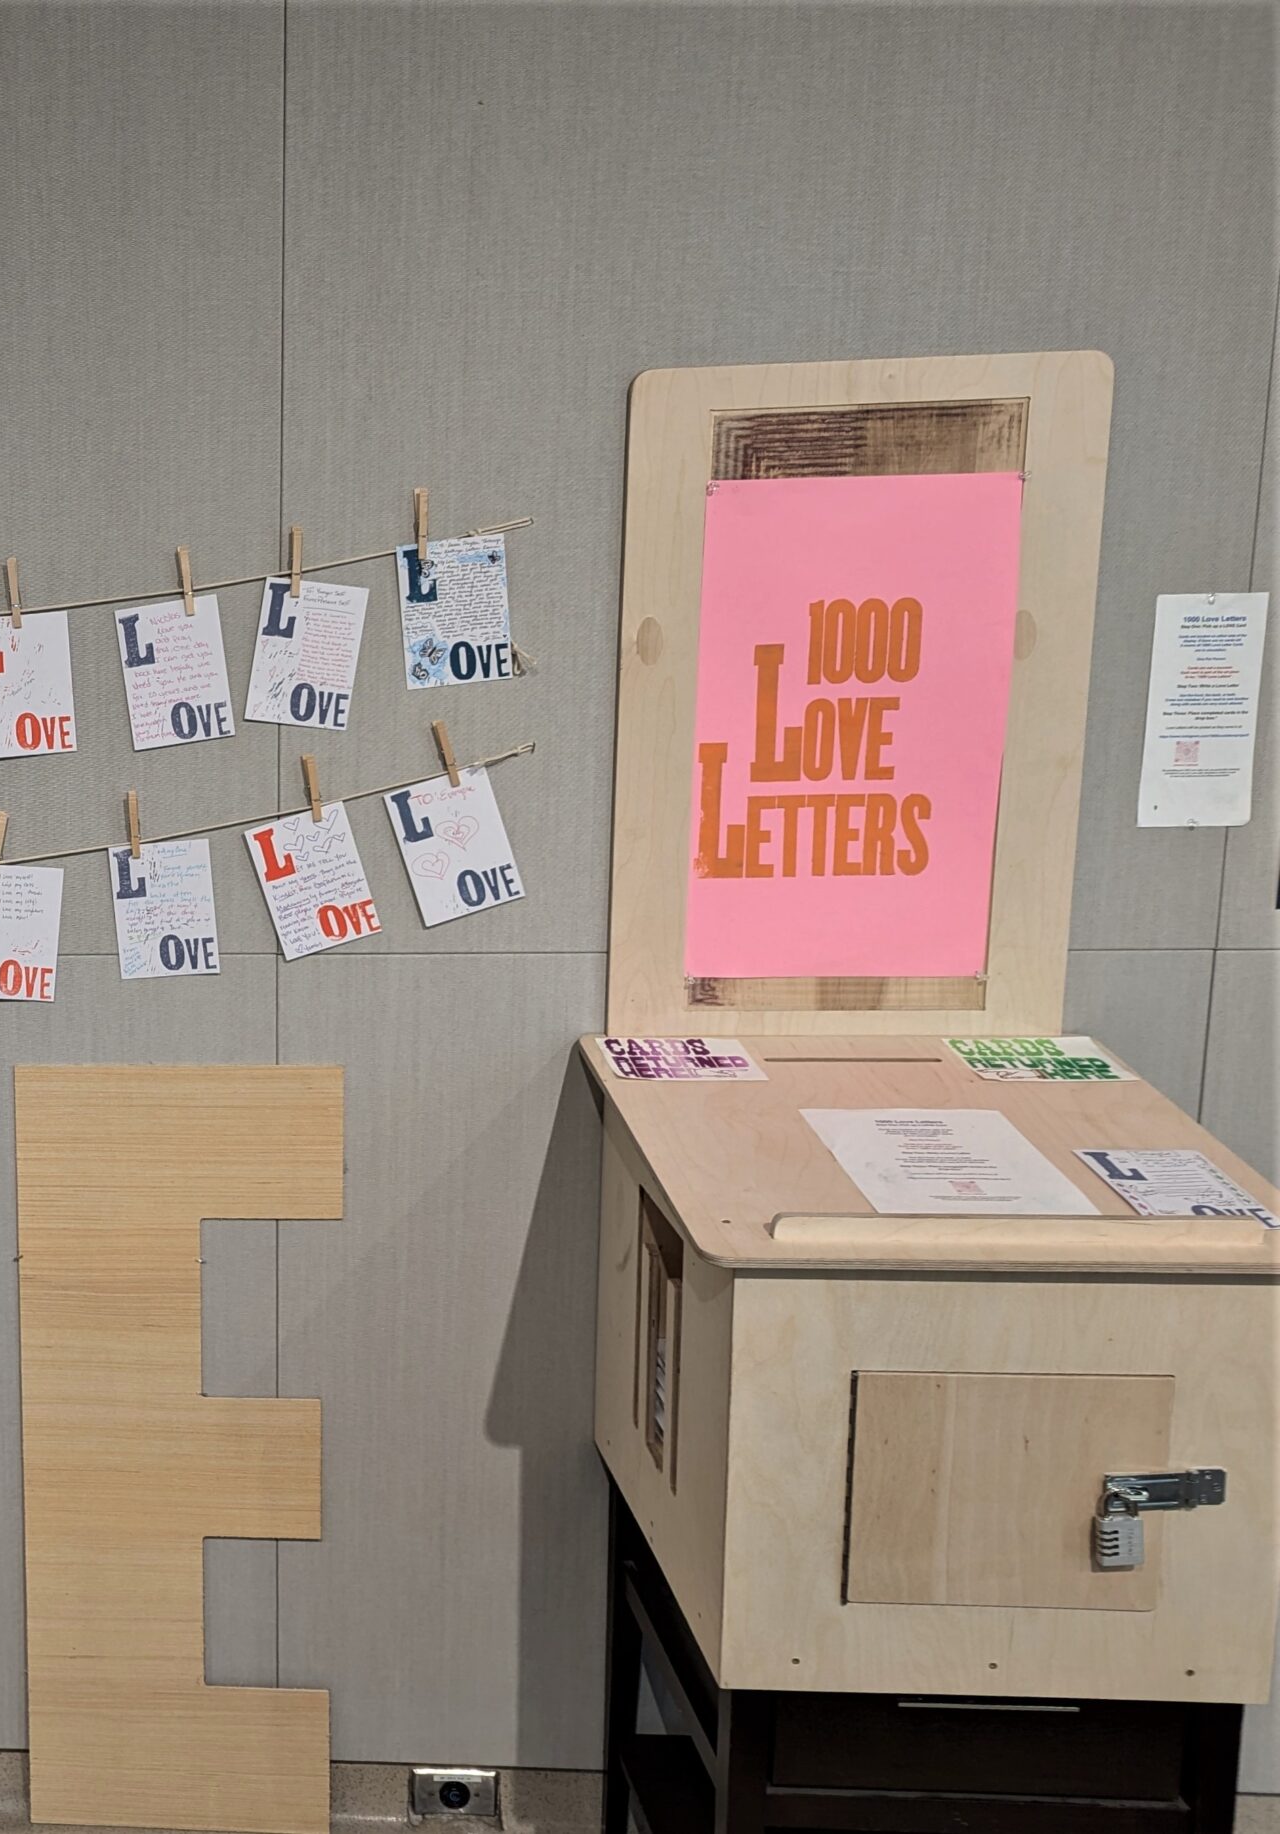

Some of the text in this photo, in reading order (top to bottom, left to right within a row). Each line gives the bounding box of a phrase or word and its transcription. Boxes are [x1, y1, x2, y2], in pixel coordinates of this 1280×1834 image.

[402, 549, 438, 603] L
[262, 582, 296, 638] L
[118, 614, 156, 668] L
[450, 641, 511, 680] OVE
[807, 597, 924, 686] 1000
[170, 700, 231, 740] OVE
[290, 682, 350, 728] OVE
[750, 644, 901, 783] LOVE
[15, 712, 73, 750] OVE
[390, 790, 433, 843] L
[695, 742, 932, 879] LETTERS
[114, 849, 147, 900] L
[252, 828, 297, 883] L
[457, 864, 520, 907] OVE
[315, 898, 382, 942] OVE
[159, 934, 218, 970] OVE
[604, 1038, 710, 1056] CARDS
[612, 1056, 750, 1068] RETURNED
[948, 1038, 1064, 1056] CARDS
[963, 1057, 1112, 1068] RETURNED
[1039, 1069, 1120, 1079] HERE
